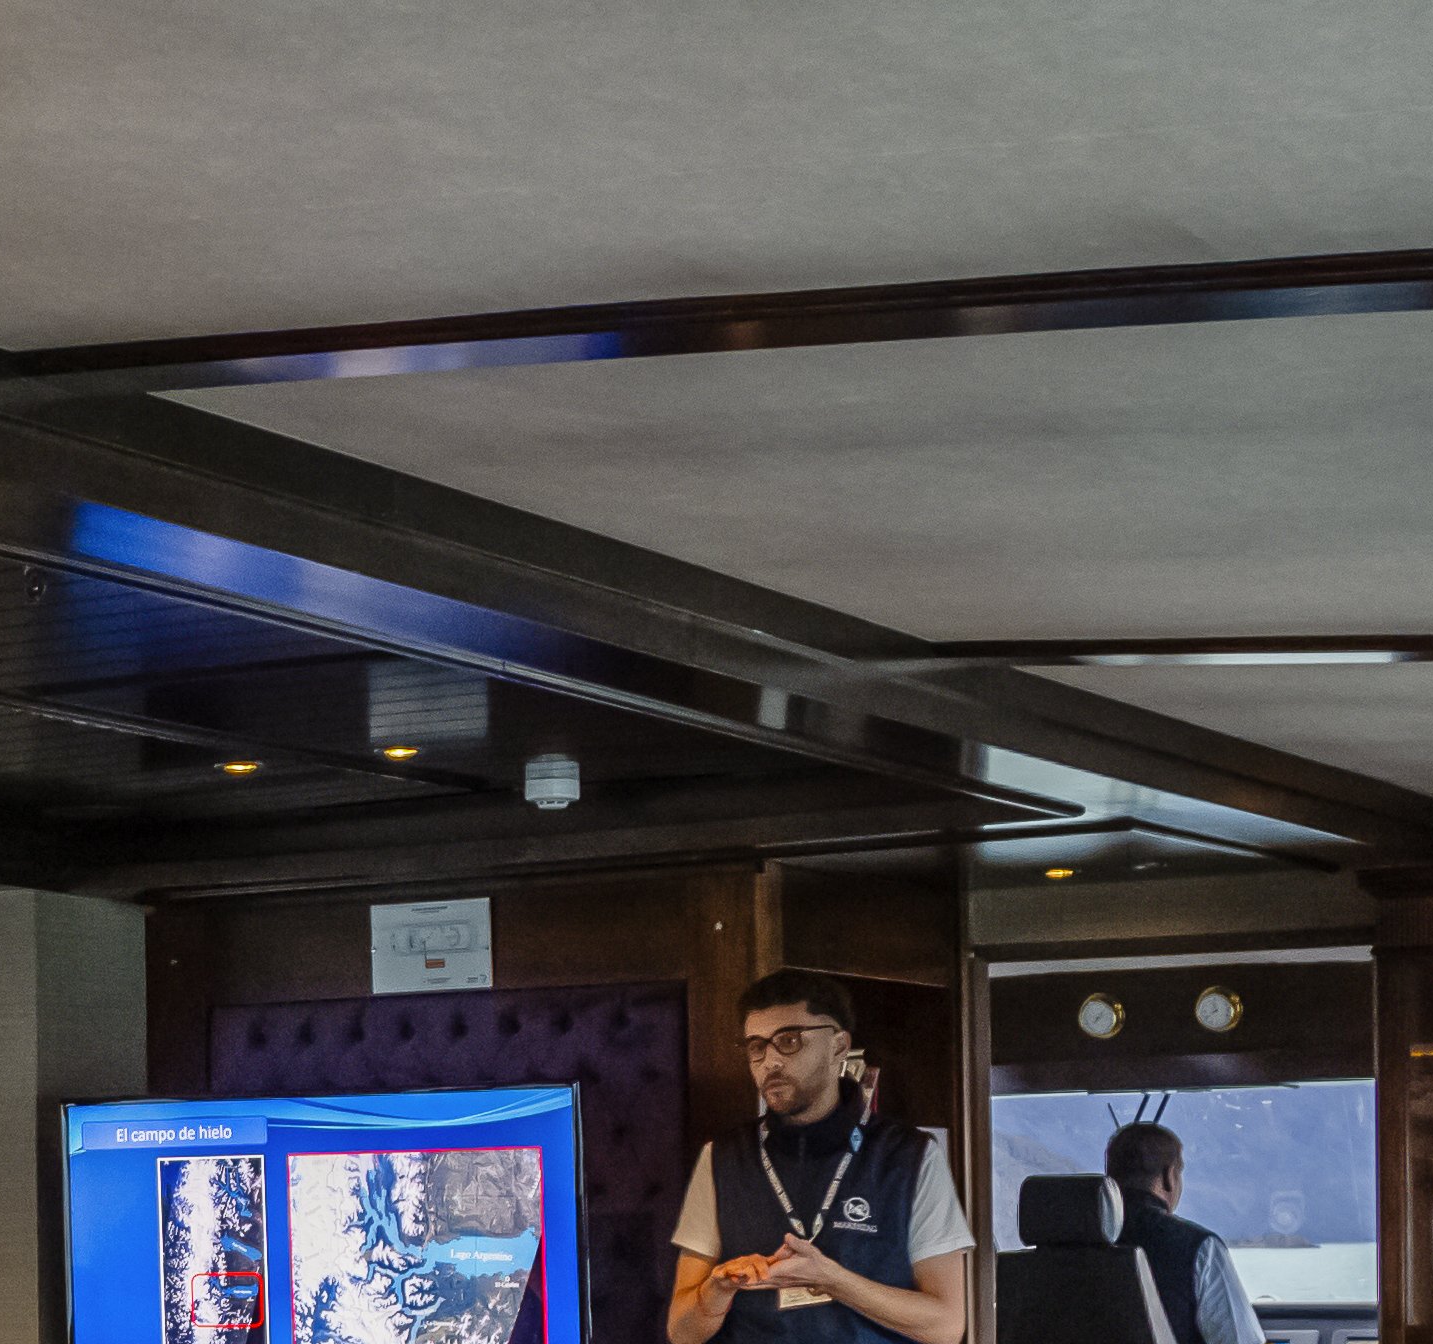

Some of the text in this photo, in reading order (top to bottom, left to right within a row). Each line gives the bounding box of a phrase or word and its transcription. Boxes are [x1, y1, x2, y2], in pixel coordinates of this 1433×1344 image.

[116, 1124, 232, 1144] El campo de hielo
